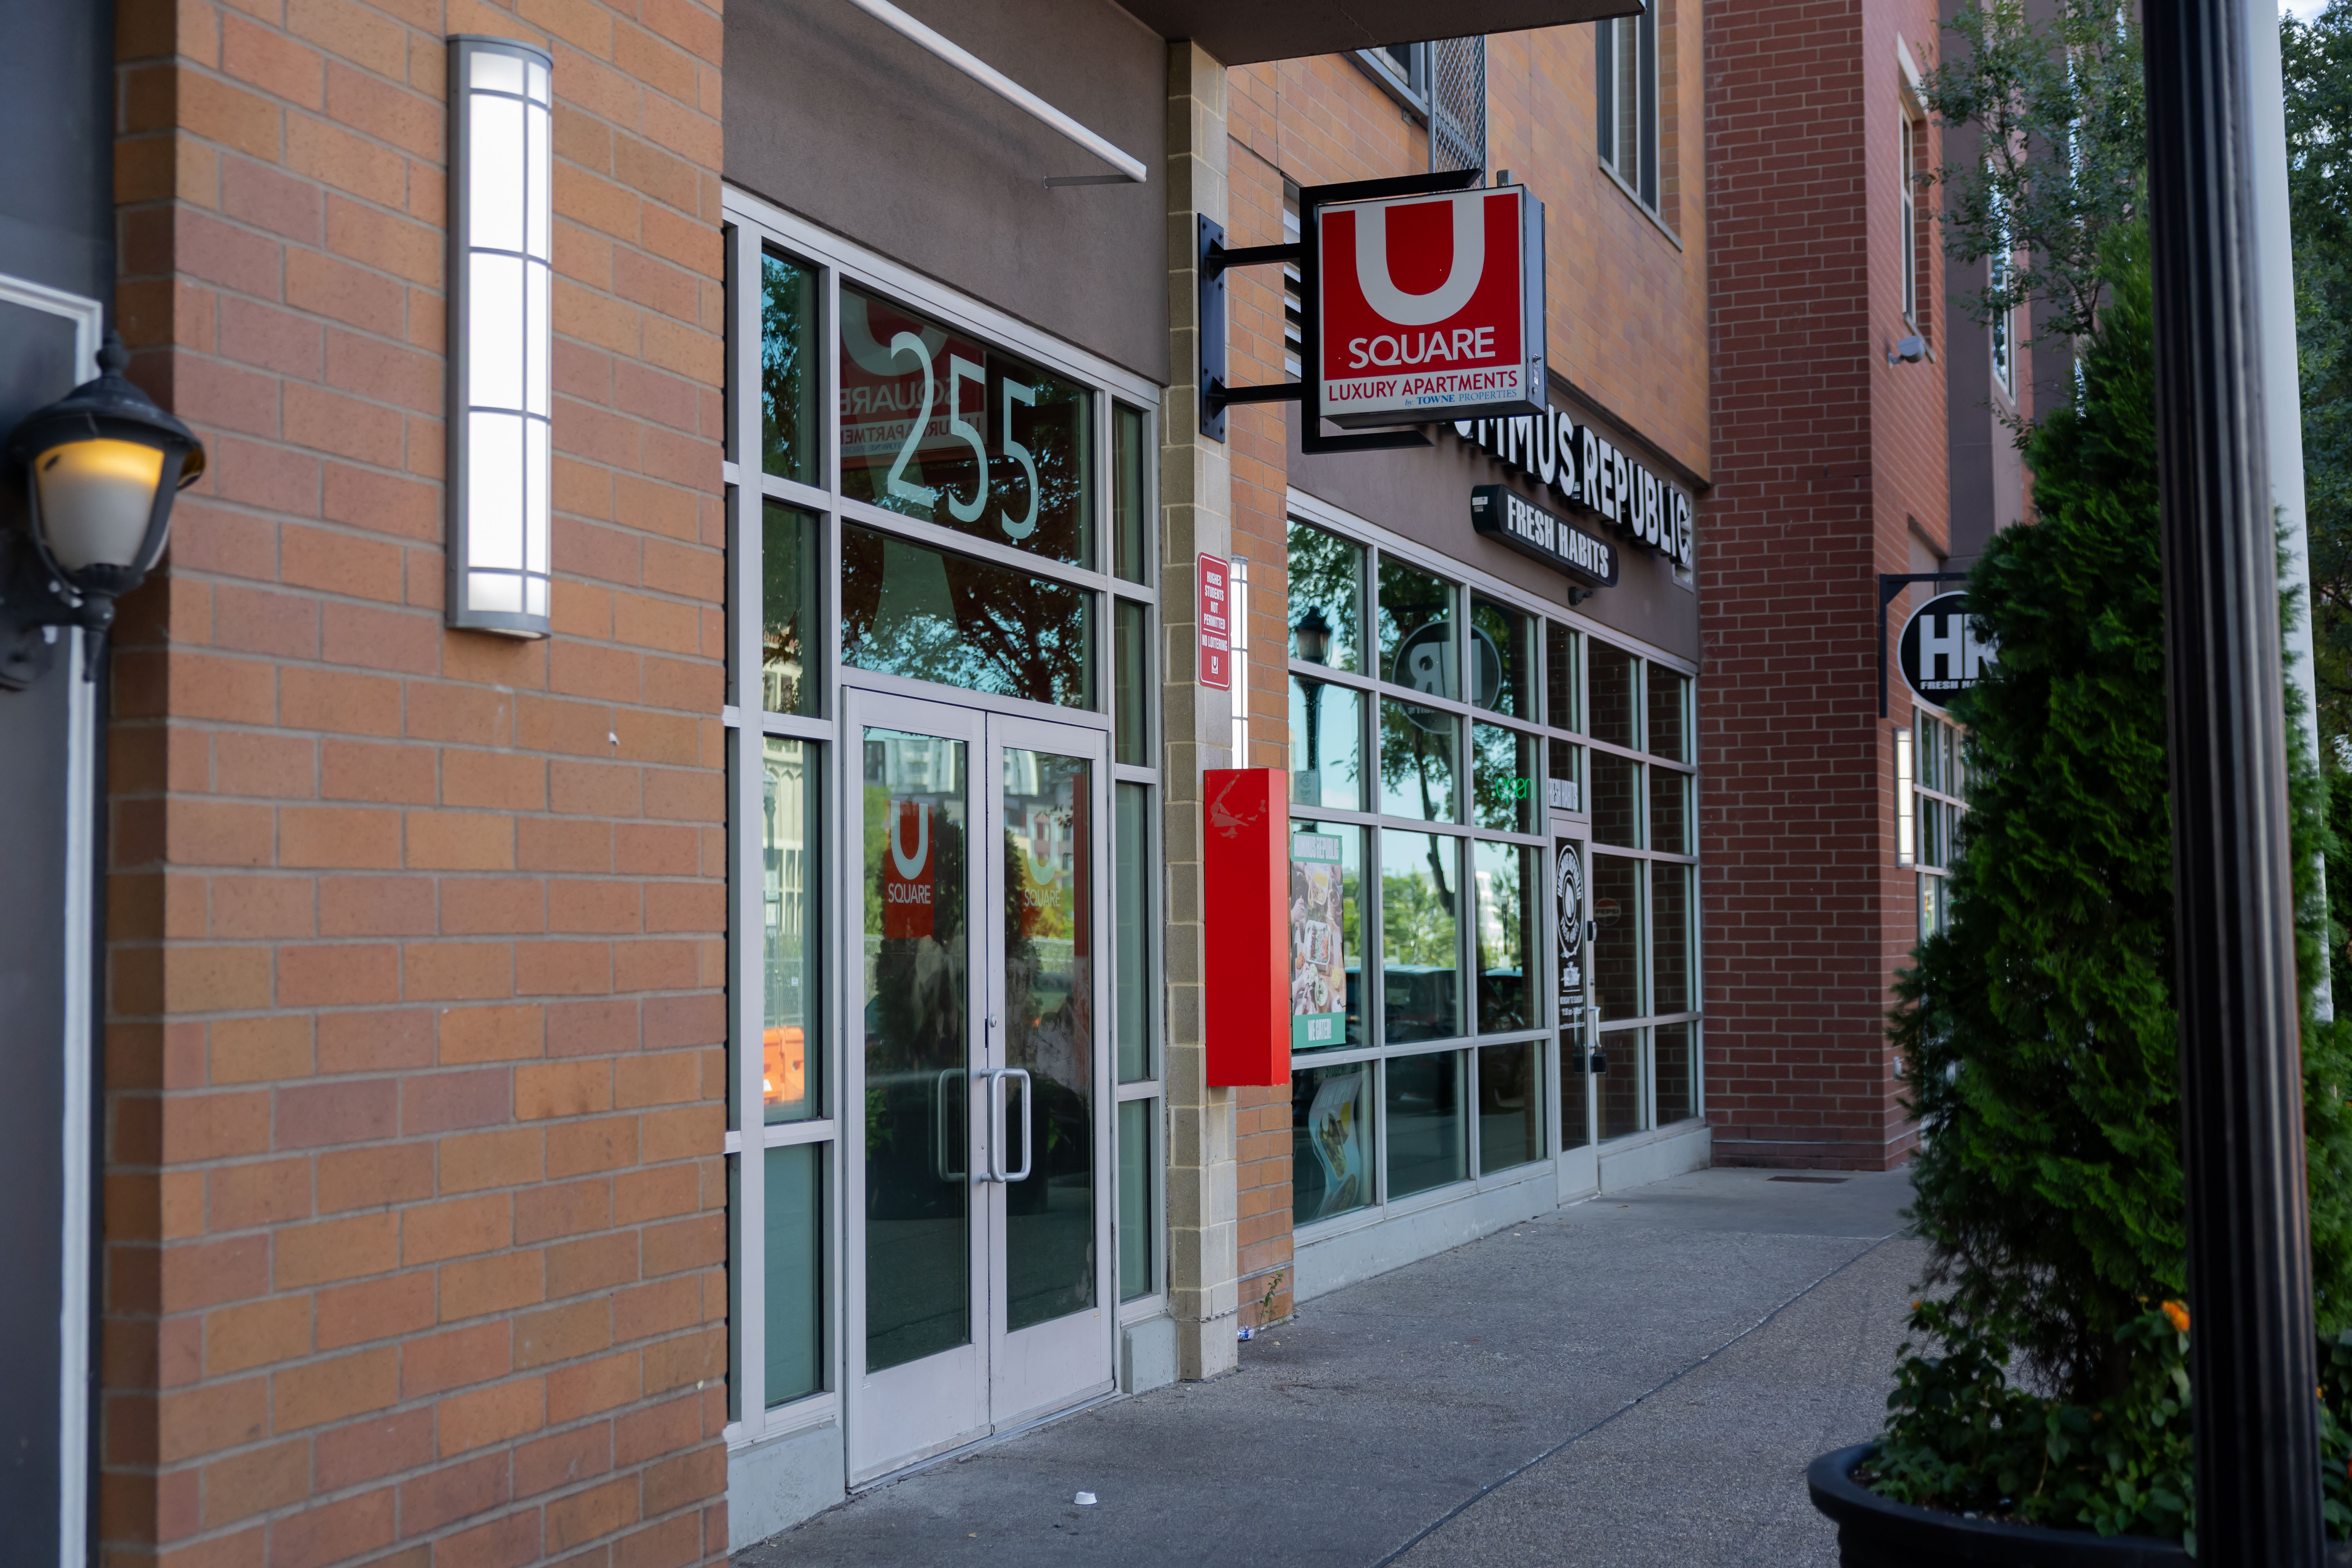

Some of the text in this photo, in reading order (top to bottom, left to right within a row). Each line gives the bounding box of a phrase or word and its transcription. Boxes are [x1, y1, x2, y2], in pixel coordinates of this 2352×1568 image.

[1355, 196, 1485, 326] U
[1348, 326, 1496, 369] SQUARE
[1329, 380, 1397, 402] LUXURY
[1401, 370, 1517, 396] APARTMENTS
[1417, 394, 1455, 405] TOWNE
[1459, 388, 1517, 402] PROPERTIES
[887, 331, 1038, 539] 255
[1583, 426, 1689, 564] REPUBLIC
[1508, 494, 1609, 578] FRESH HABITS
[1207, 571, 1222, 587] HUGHES
[1205, 584, 1224, 602] STUDENTS
[1210, 601, 1218, 614] NOT
[1204, 613, 1226, 630] PERMITTED
[1202, 634, 1228, 652] NO LOITERING
[1920, 680, 1958, 690] FRESH
[891, 800, 928, 880] U
[1294, 834, 1339, 860] HUMMUS REPUBLIC
[888, 882, 931, 904] SQUARE
[1024, 888, 1061, 907] SQUARE
[1307, 1018, 1332, 1041] WE CATER!
